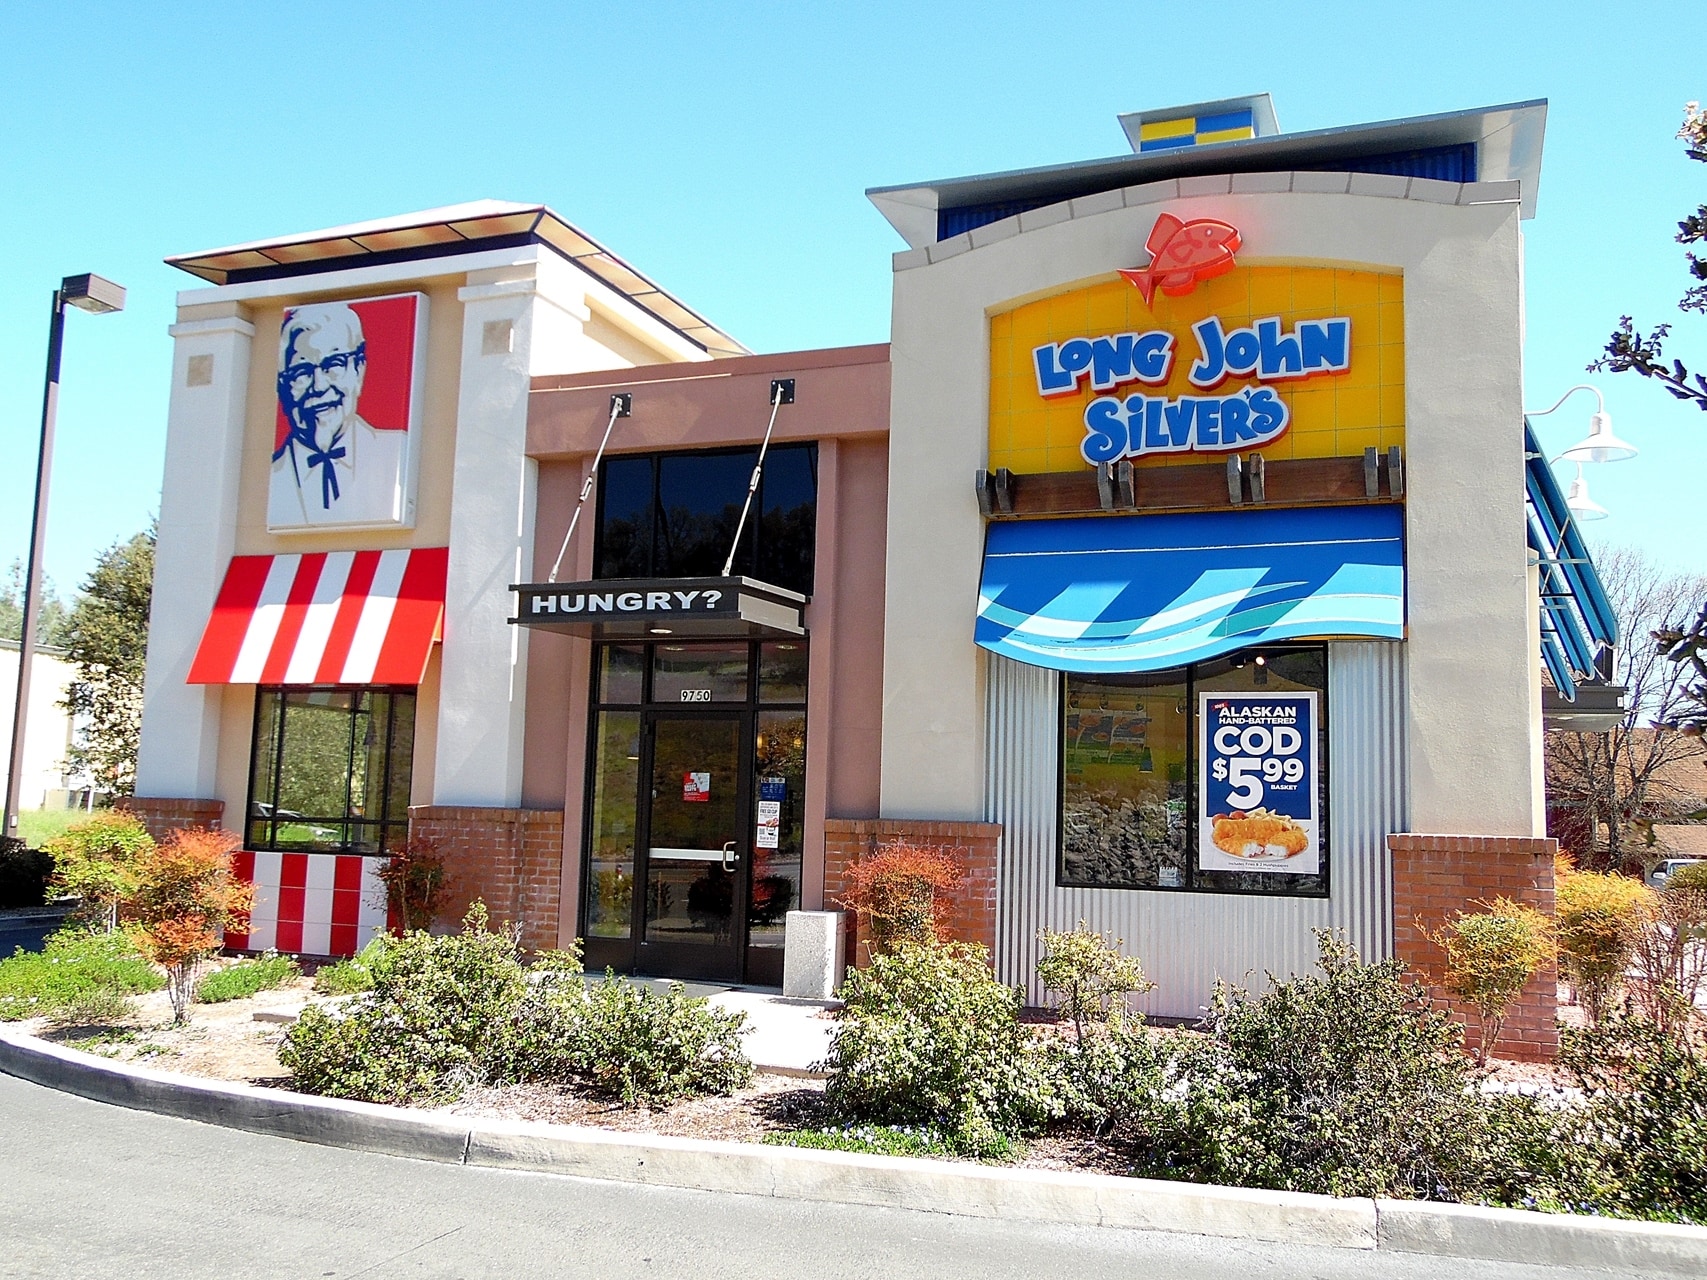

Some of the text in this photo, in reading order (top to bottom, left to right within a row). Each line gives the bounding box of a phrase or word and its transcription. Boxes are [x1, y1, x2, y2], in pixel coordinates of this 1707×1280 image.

[531, 590, 723, 614] HUNGRY?
[682, 690, 709, 701] 9750
[1219, 706, 1297, 718] ALASKAN
[1218, 717, 1297, 725] HAND-BATTERED
[1213, 726, 1302, 756] COD
